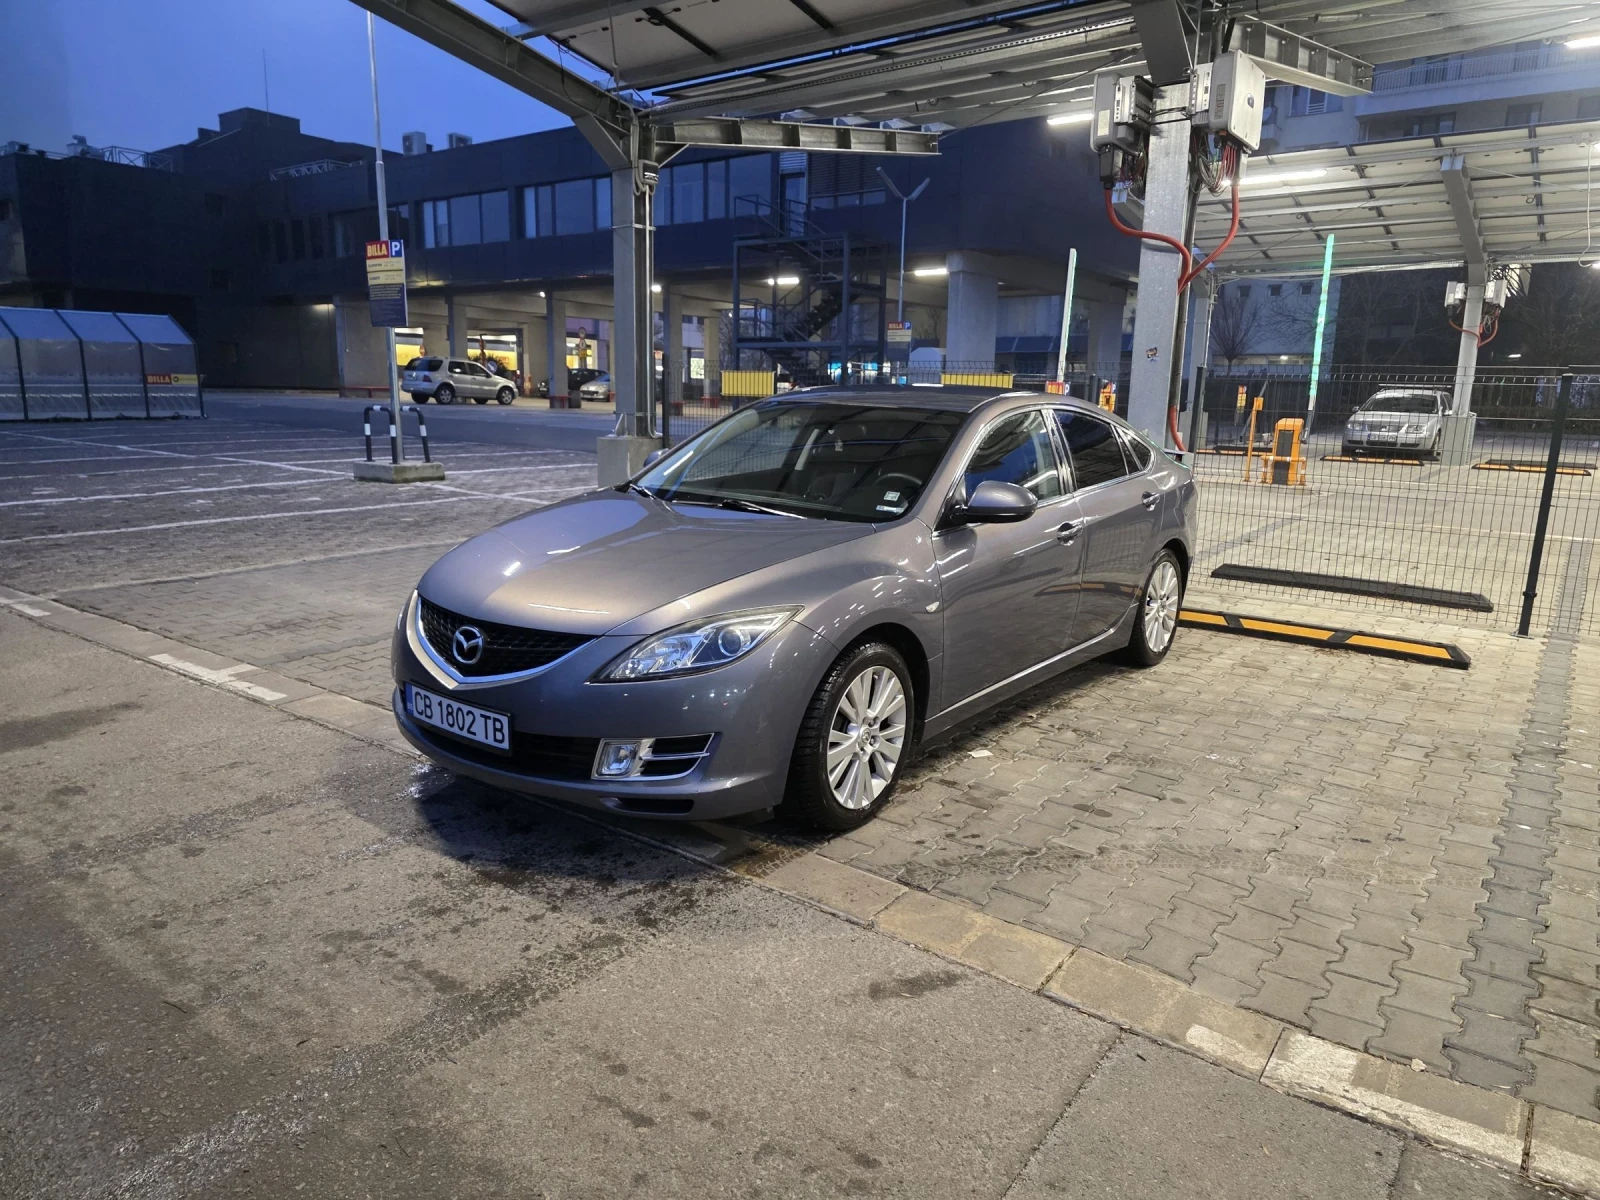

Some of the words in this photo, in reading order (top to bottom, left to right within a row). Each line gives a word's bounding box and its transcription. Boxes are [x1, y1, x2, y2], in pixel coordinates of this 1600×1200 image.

[367, 243, 387, 257] BILLA
[391, 241, 400, 256] P
[414, 691, 433, 720] CB
[437, 700, 477, 737] 1802
[479, 713, 505, 744] TB
